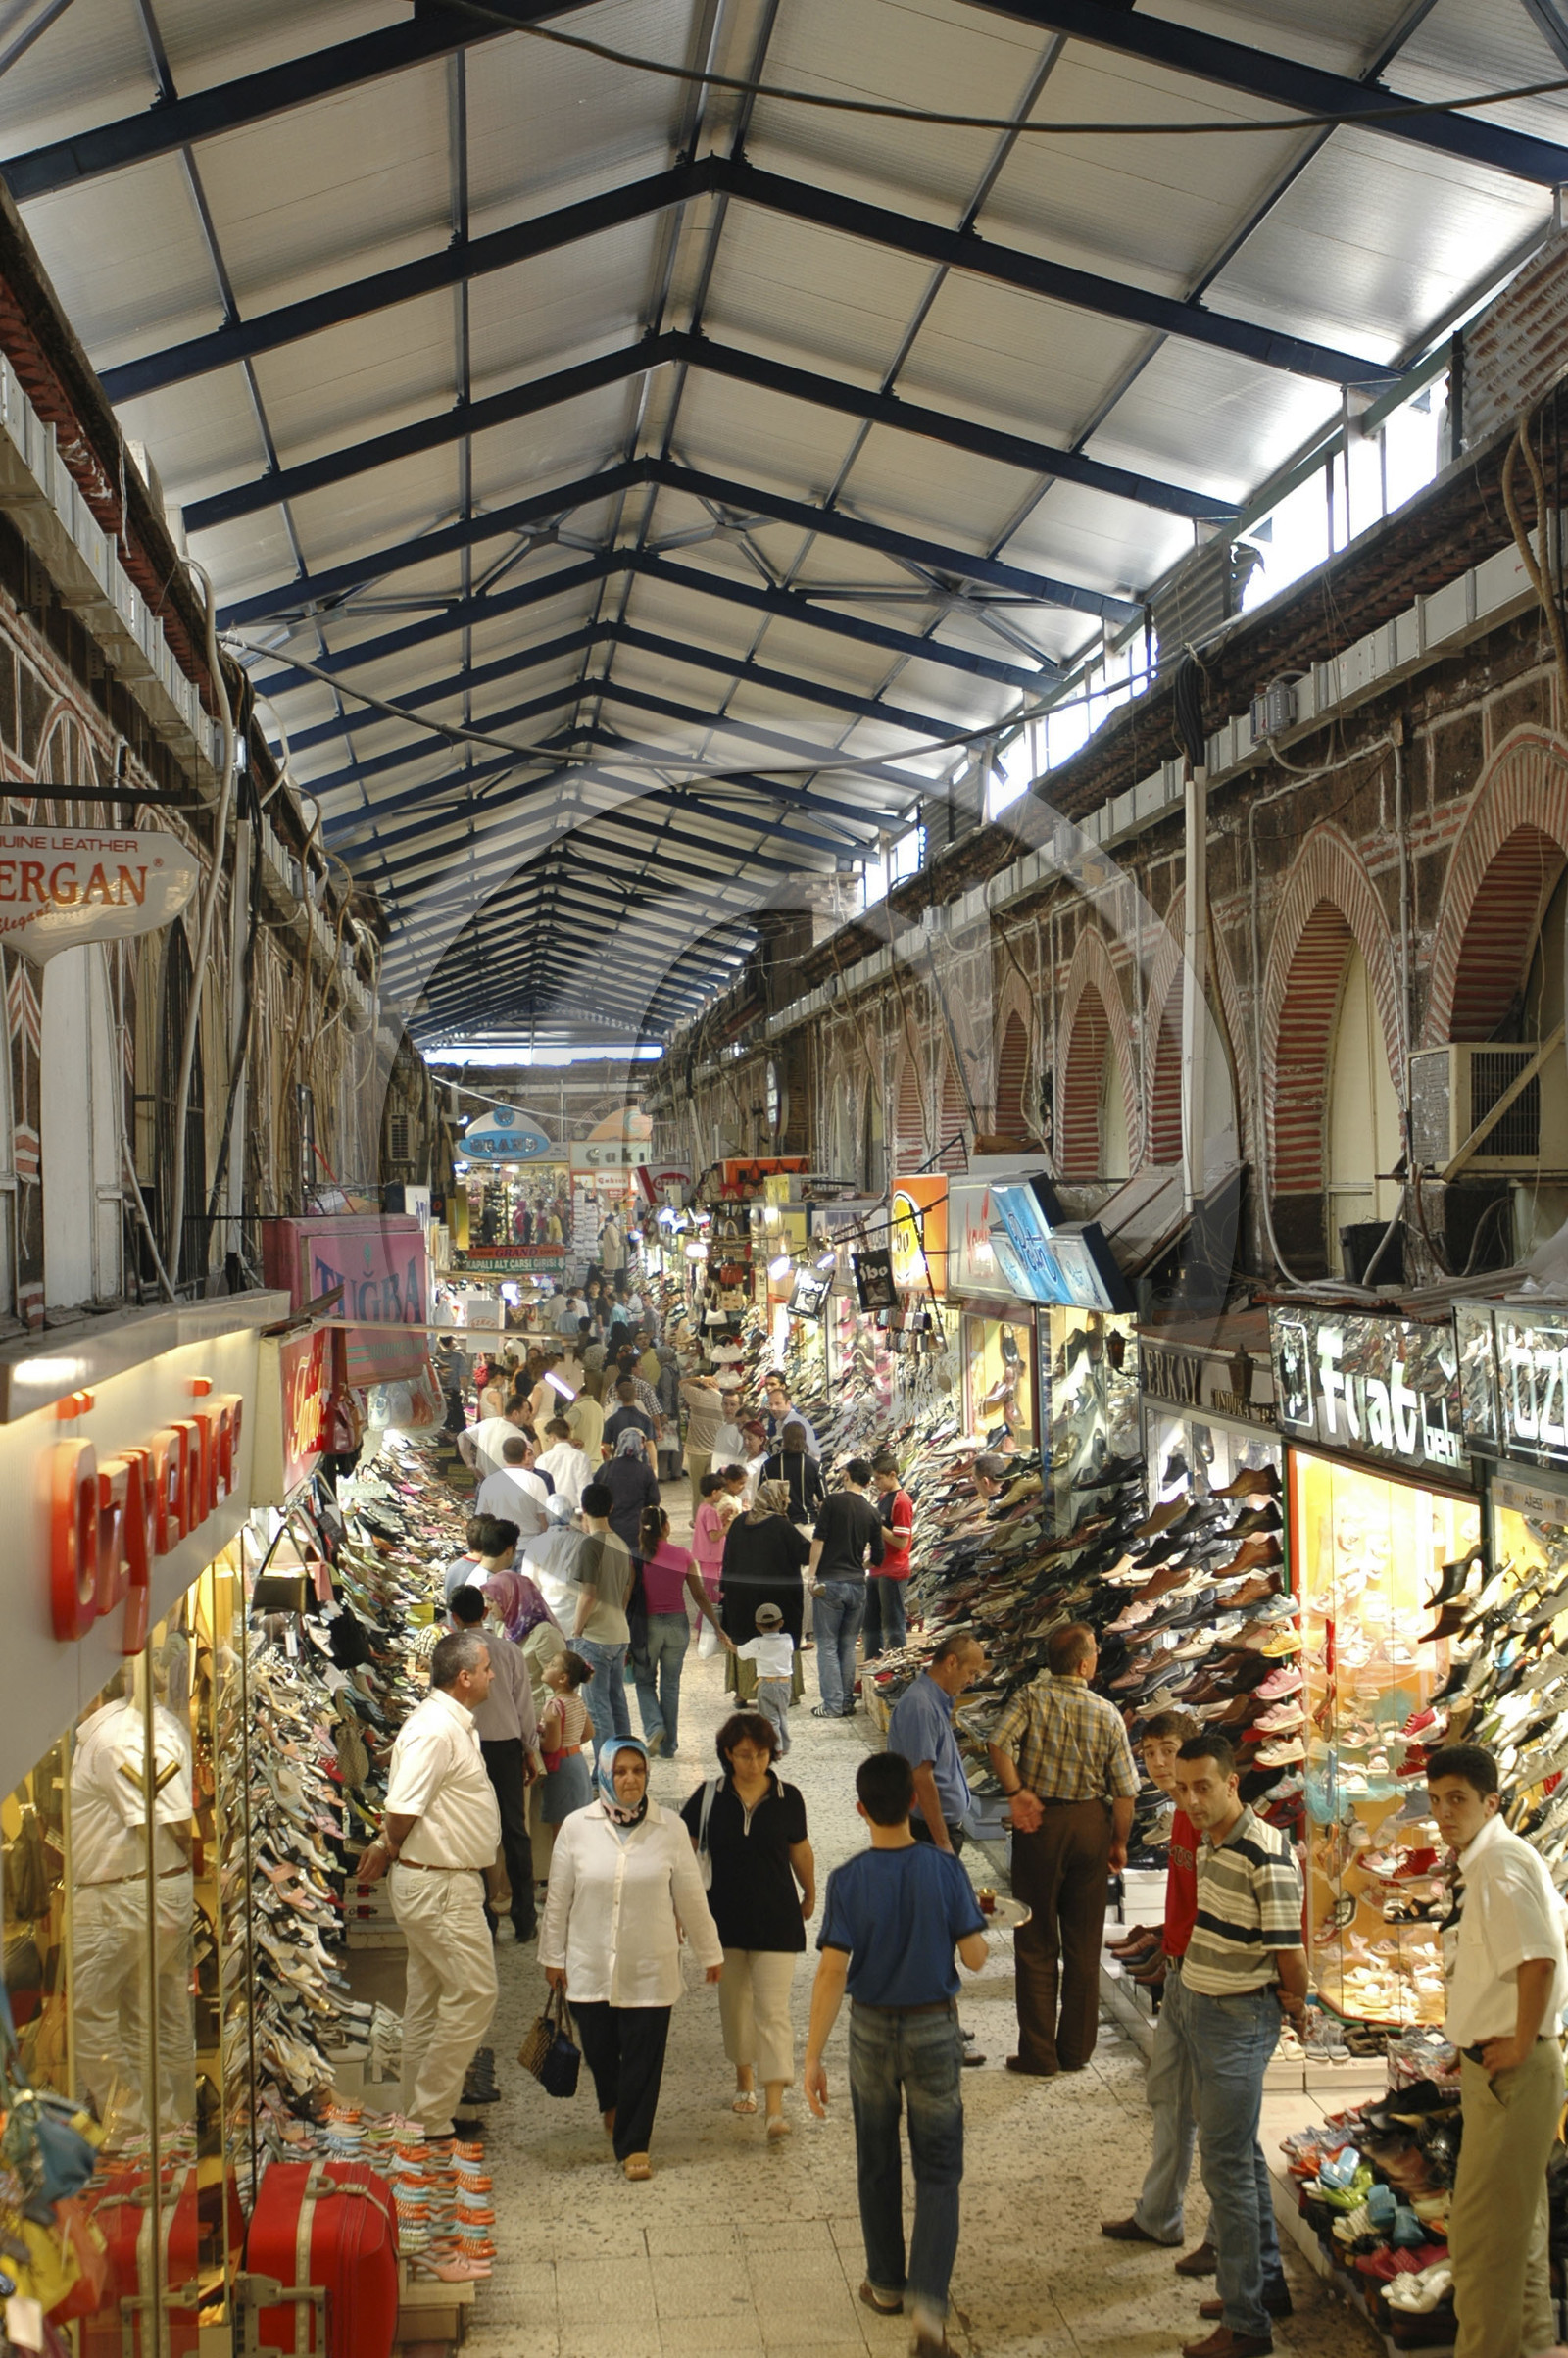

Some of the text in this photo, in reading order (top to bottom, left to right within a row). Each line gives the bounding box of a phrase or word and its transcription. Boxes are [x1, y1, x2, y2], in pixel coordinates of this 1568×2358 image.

[0, 836, 139, 853] UINE LEATHER
[469, 1137, 539, 1154] GRAND
[495, 1248, 538, 1257] GRAND
[1143, 1350, 1200, 1405] ERKAY
